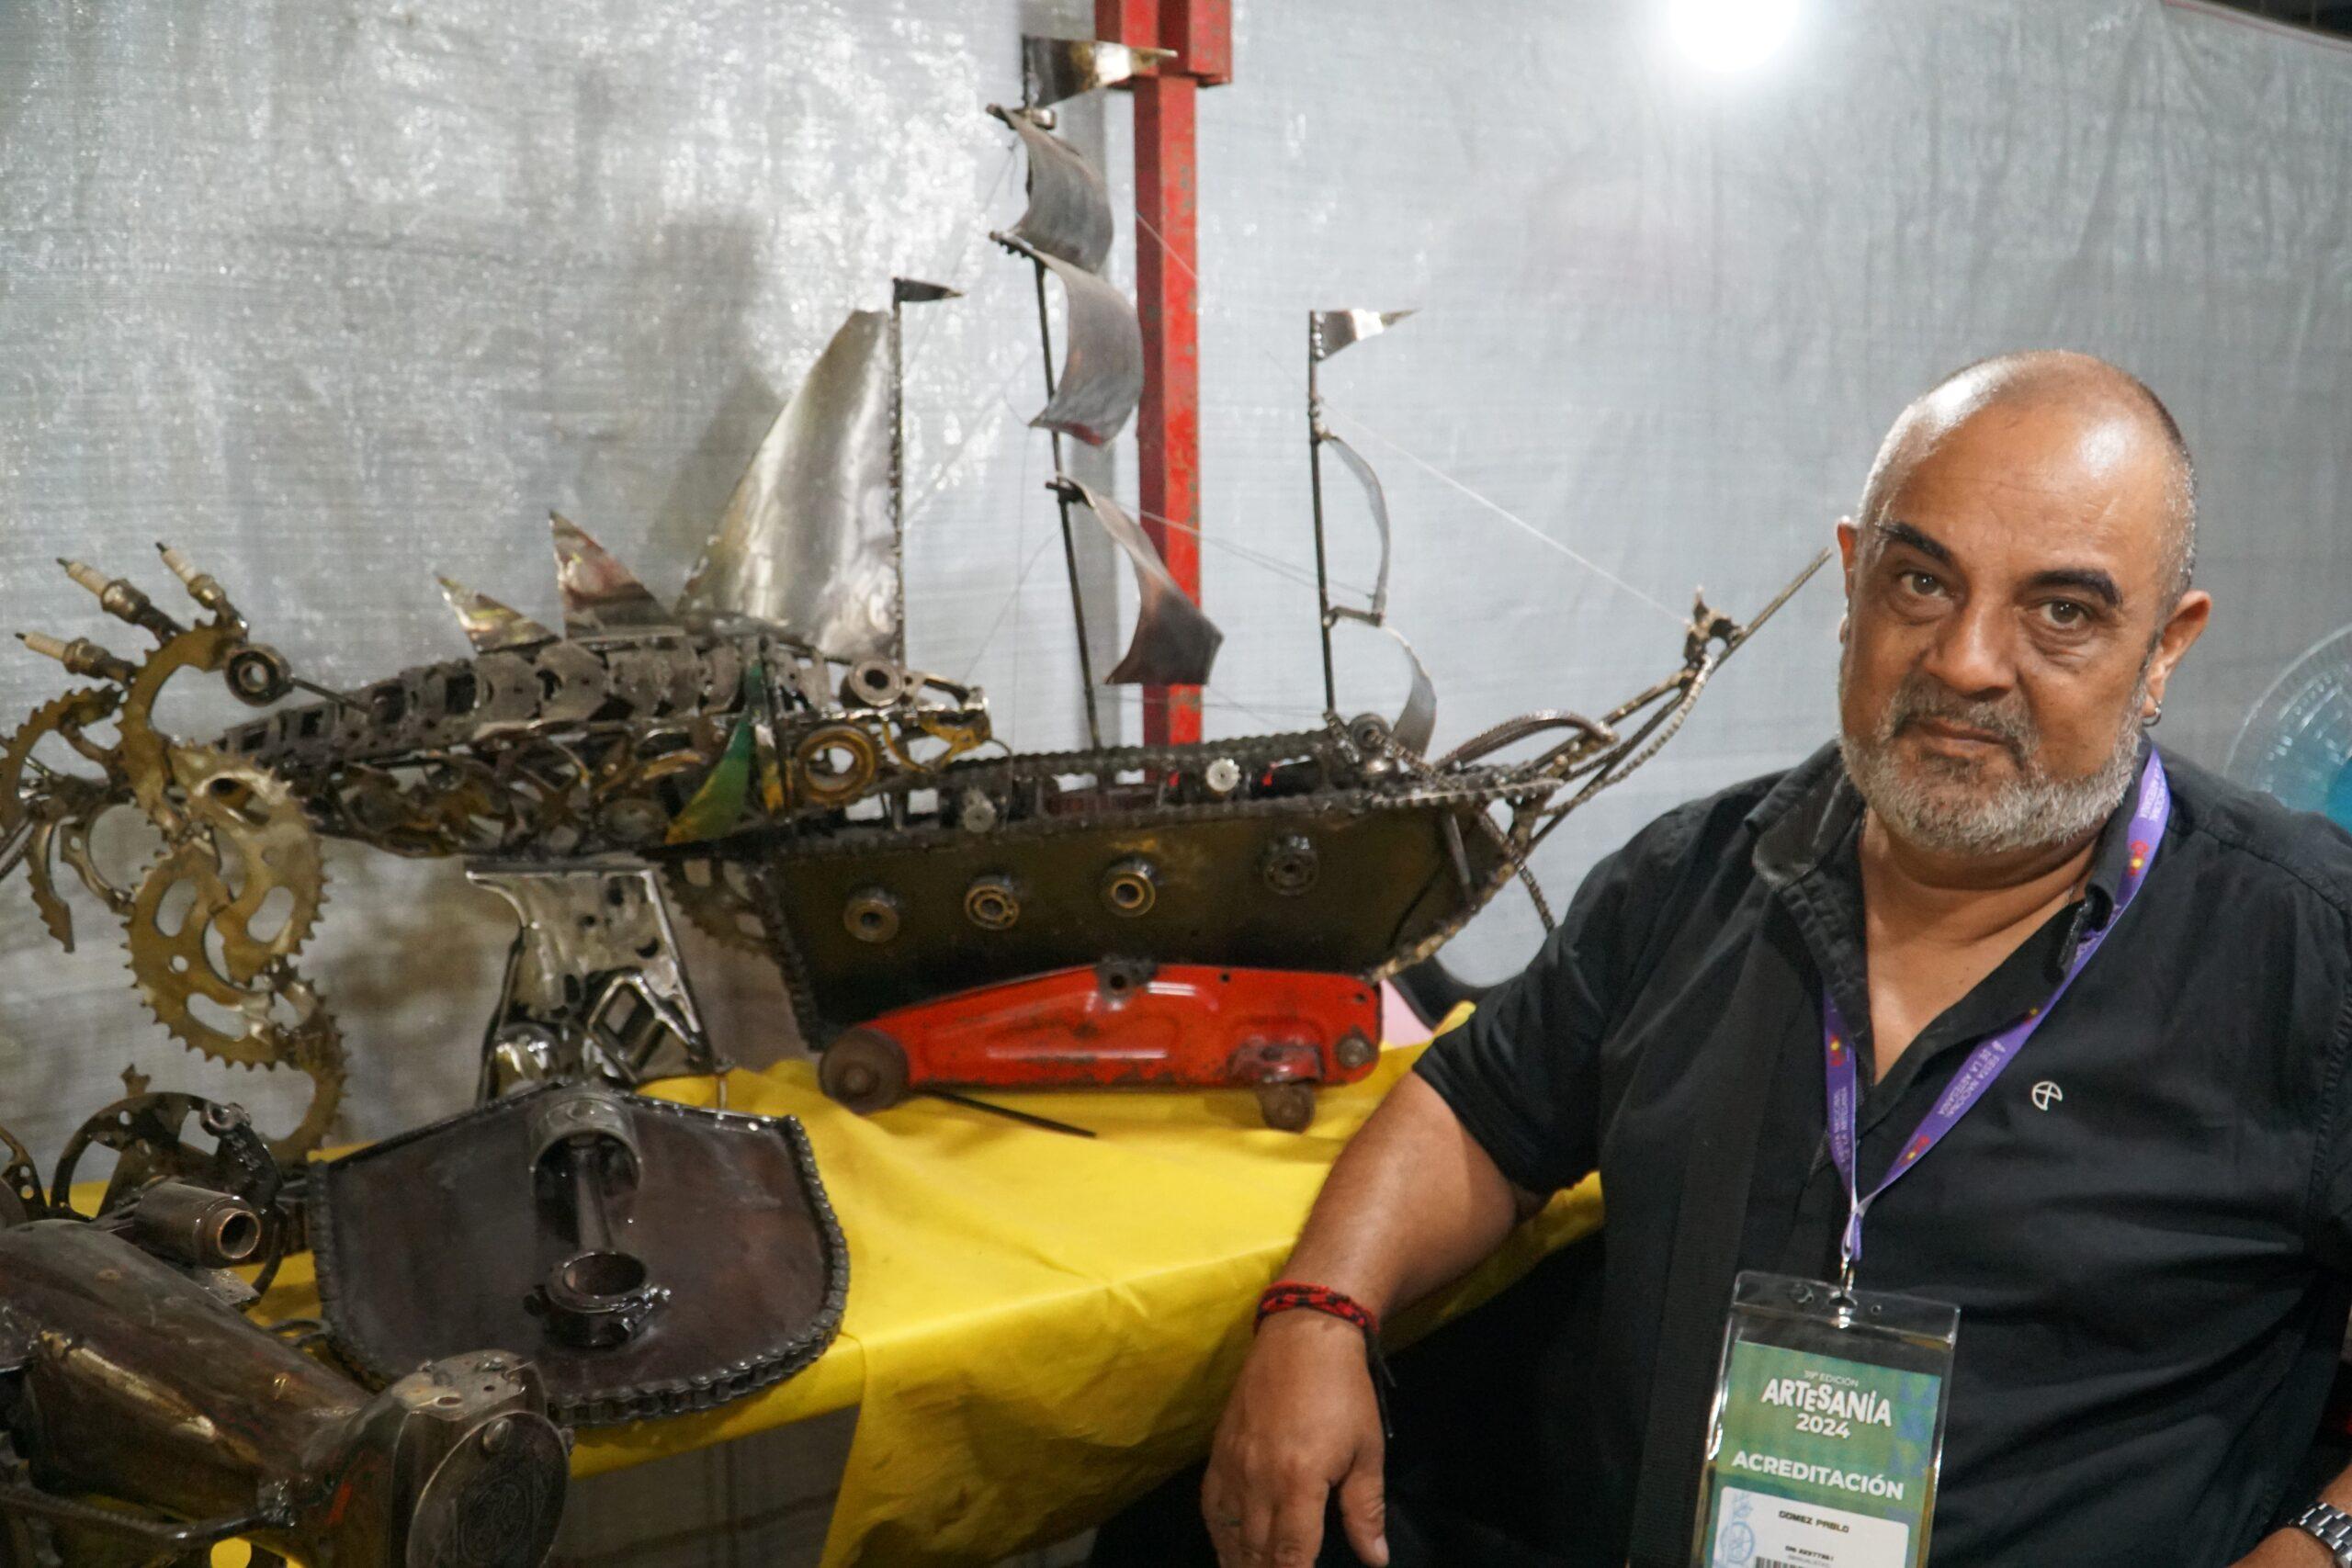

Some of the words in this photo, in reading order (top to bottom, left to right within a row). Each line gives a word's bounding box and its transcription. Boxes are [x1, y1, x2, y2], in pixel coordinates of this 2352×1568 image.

[1761, 1378, 1892, 1427] ARTESANÍA
[1795, 1413, 1851, 1438] 2024
[1732, 1450, 1905, 1501] ACREDITACIÓN
[1815, 1519, 1849, 1533] PABLO
